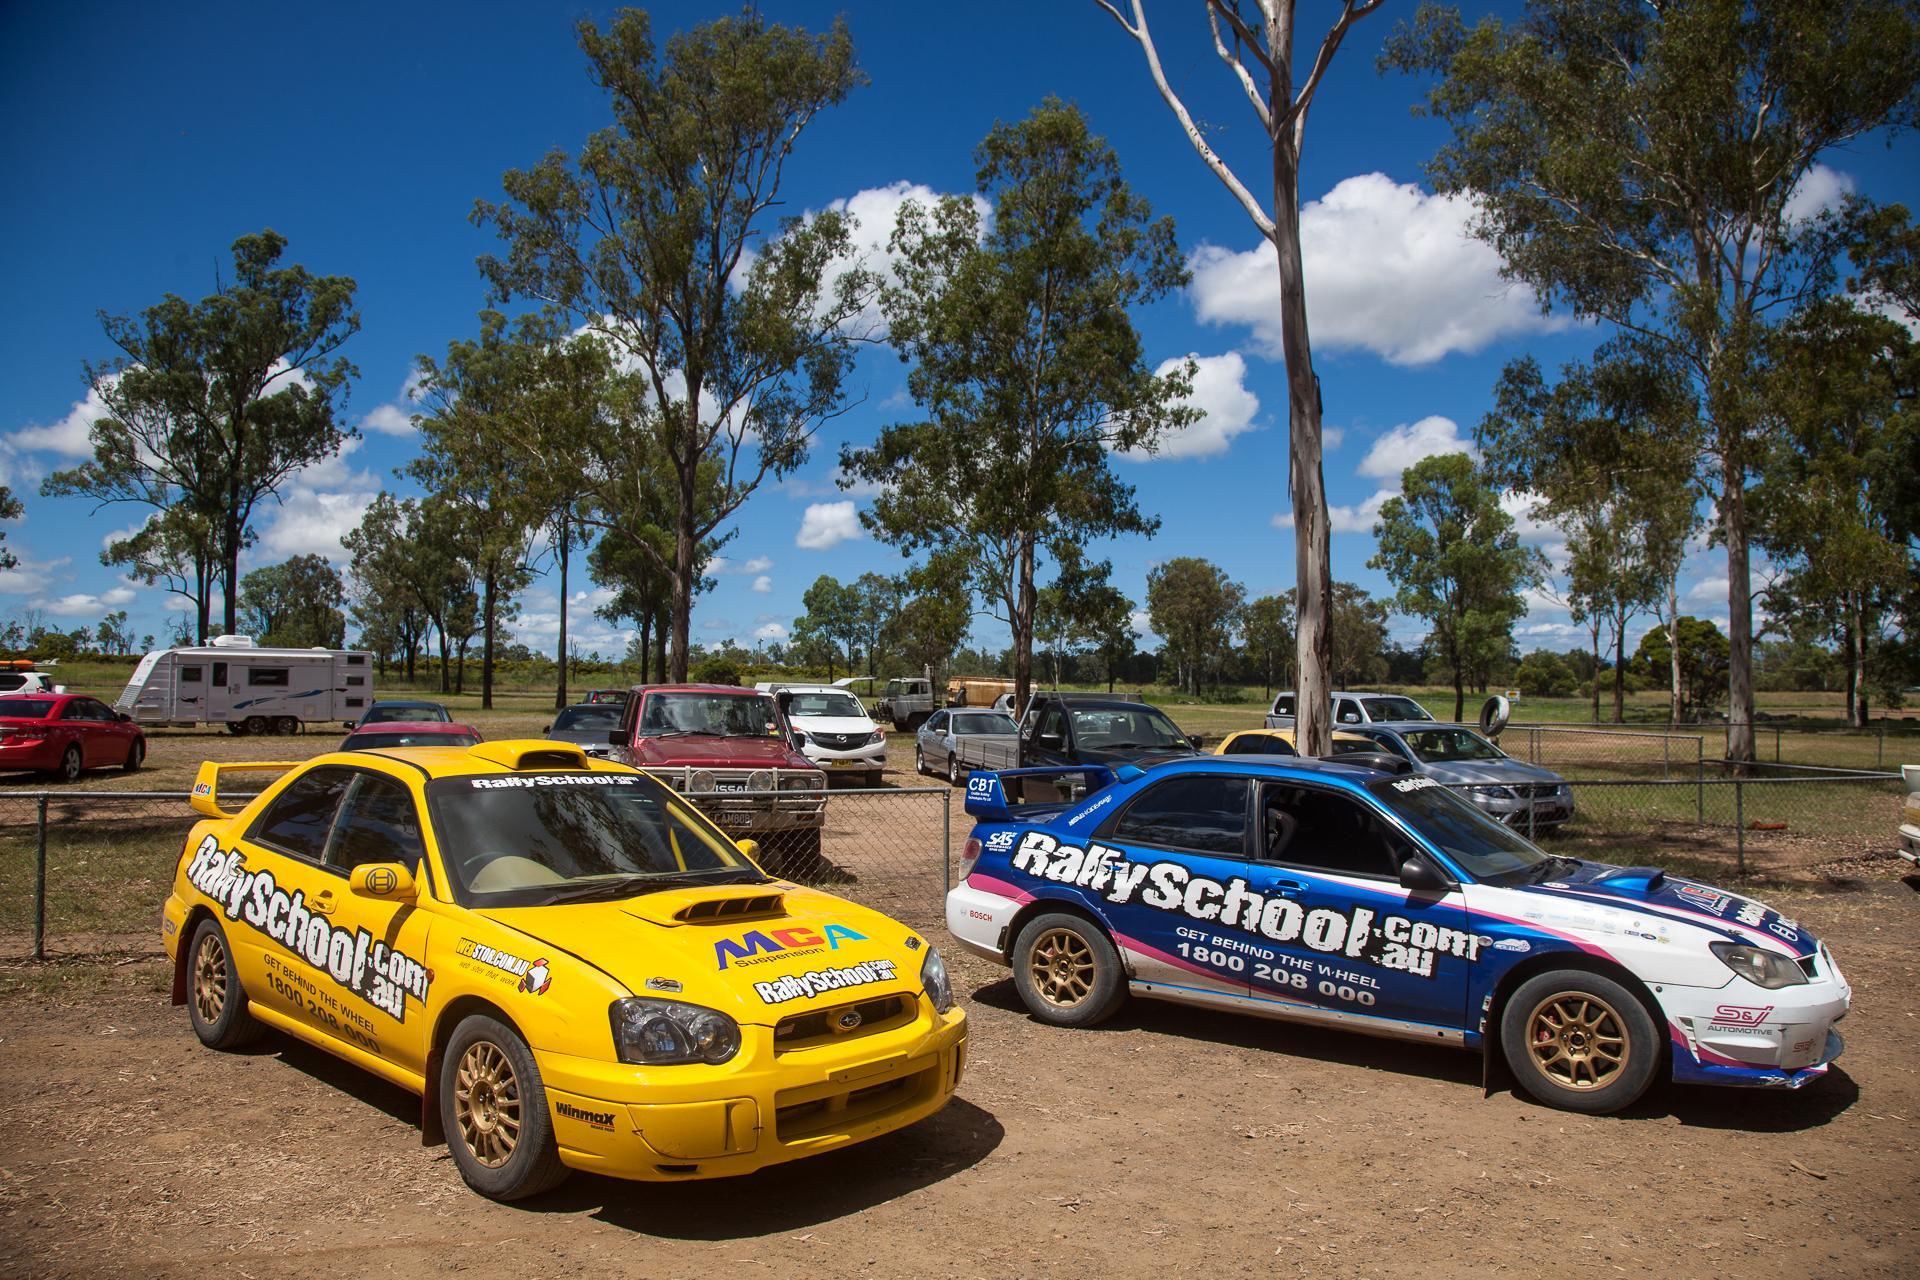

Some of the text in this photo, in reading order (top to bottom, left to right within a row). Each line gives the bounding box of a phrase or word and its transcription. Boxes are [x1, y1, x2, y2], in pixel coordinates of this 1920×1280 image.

[968, 777, 997, 792] CBT
[986, 832, 1016, 846] SAS
[969, 910, 993, 922] BOSCH
[713, 924, 869, 971] MCA
[734, 947, 826, 968] Suspension
[1175, 926, 1381, 990] GET BEHIND THE WHEEL
[1176, 942, 1377, 1007] 1800 208 000
[263, 953, 378, 1036] GET BEHIND THE WHEEL
[266, 972, 382, 1055] 1800 208 000
[1707, 1025, 1773, 1036] AUTOMOTIVE
